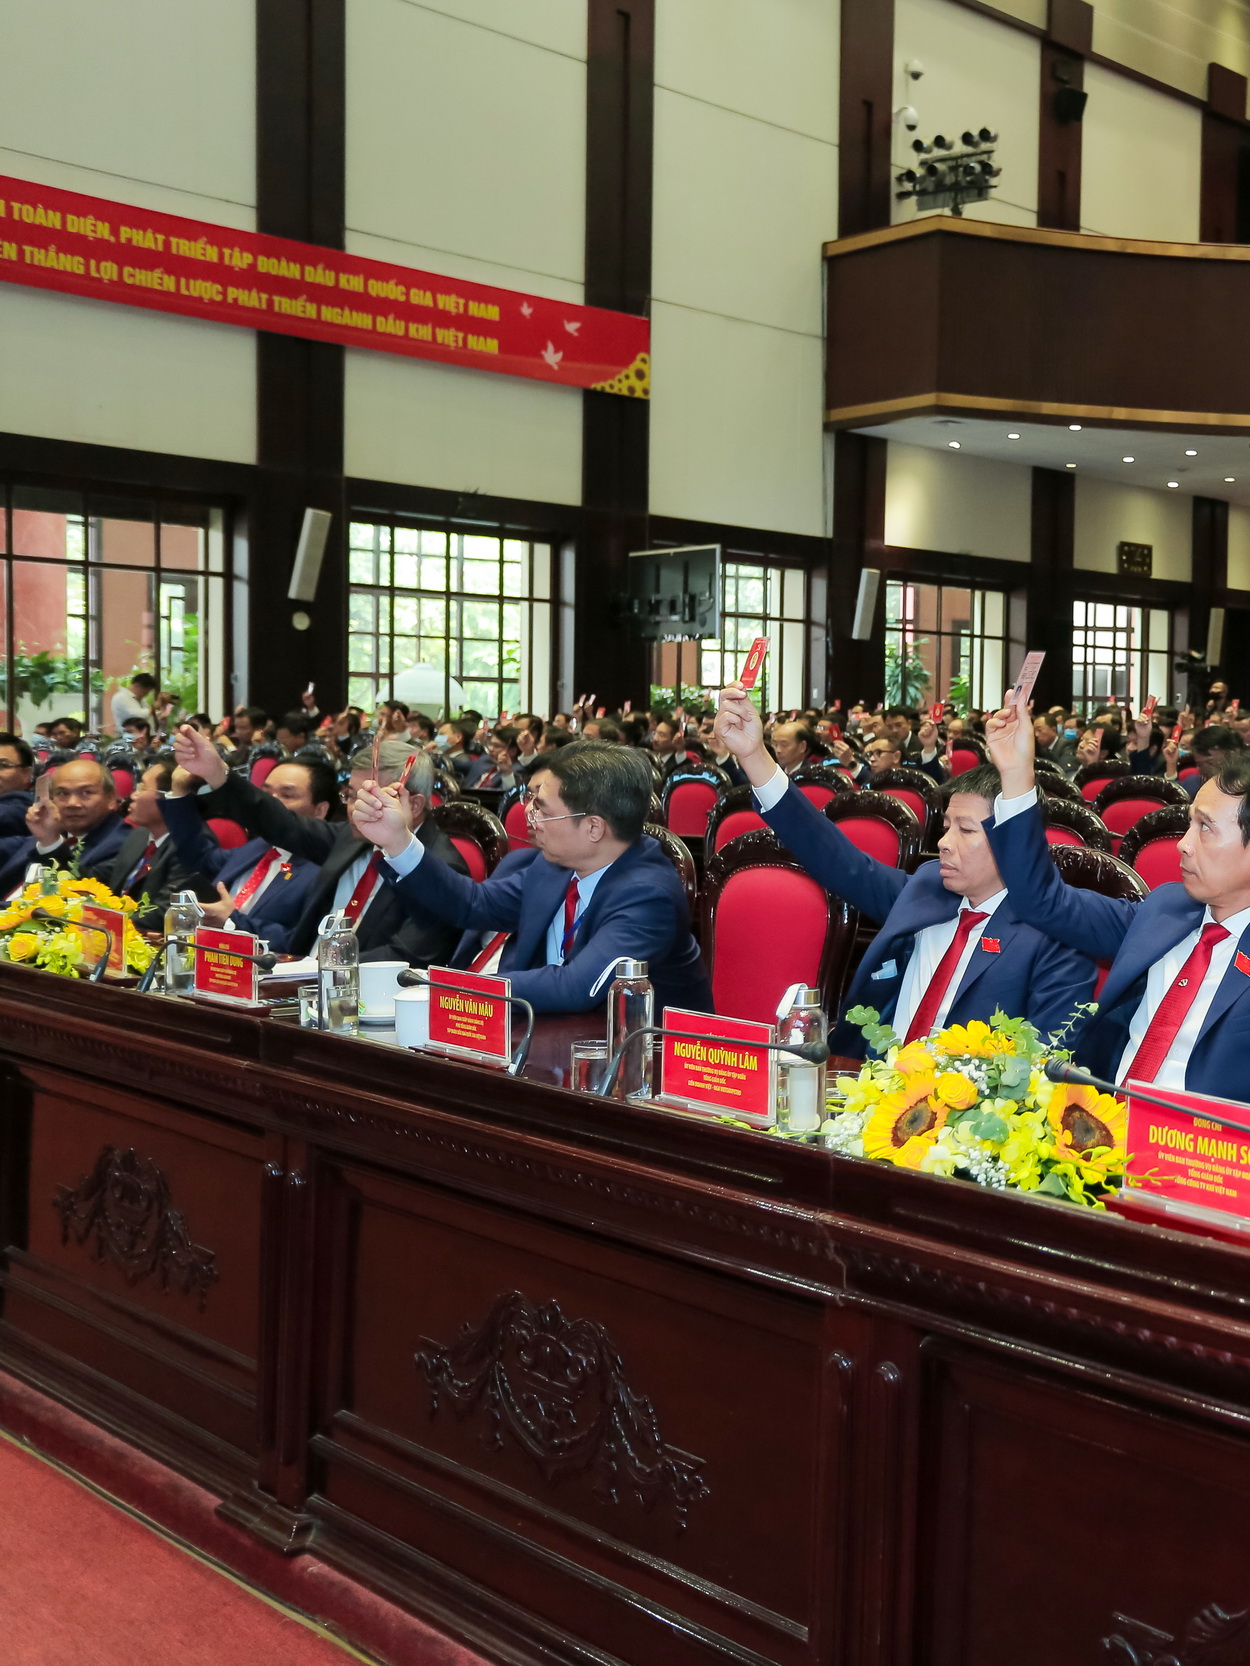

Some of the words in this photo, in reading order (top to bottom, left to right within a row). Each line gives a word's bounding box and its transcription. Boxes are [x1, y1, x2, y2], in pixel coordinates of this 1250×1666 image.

[409, 287, 434, 308] GIA
[436, 294, 465, 316] VIỆT
[467, 300, 500, 322] NAM
[467, 334, 499, 355] NAM
[439, 994, 464, 1012] NGUYỄN
[464, 998, 478, 1015] VĂN
[478, 1001, 493, 1020] MẬU
[674, 1041, 707, 1062] NGUYỄN
[708, 1046, 738, 1067] QUỲNH
[738, 1051, 758, 1071] LÂM
[1149, 1124, 1195, 1152] DƯƠNG
[1197, 1135, 1237, 1163] MẠNH
